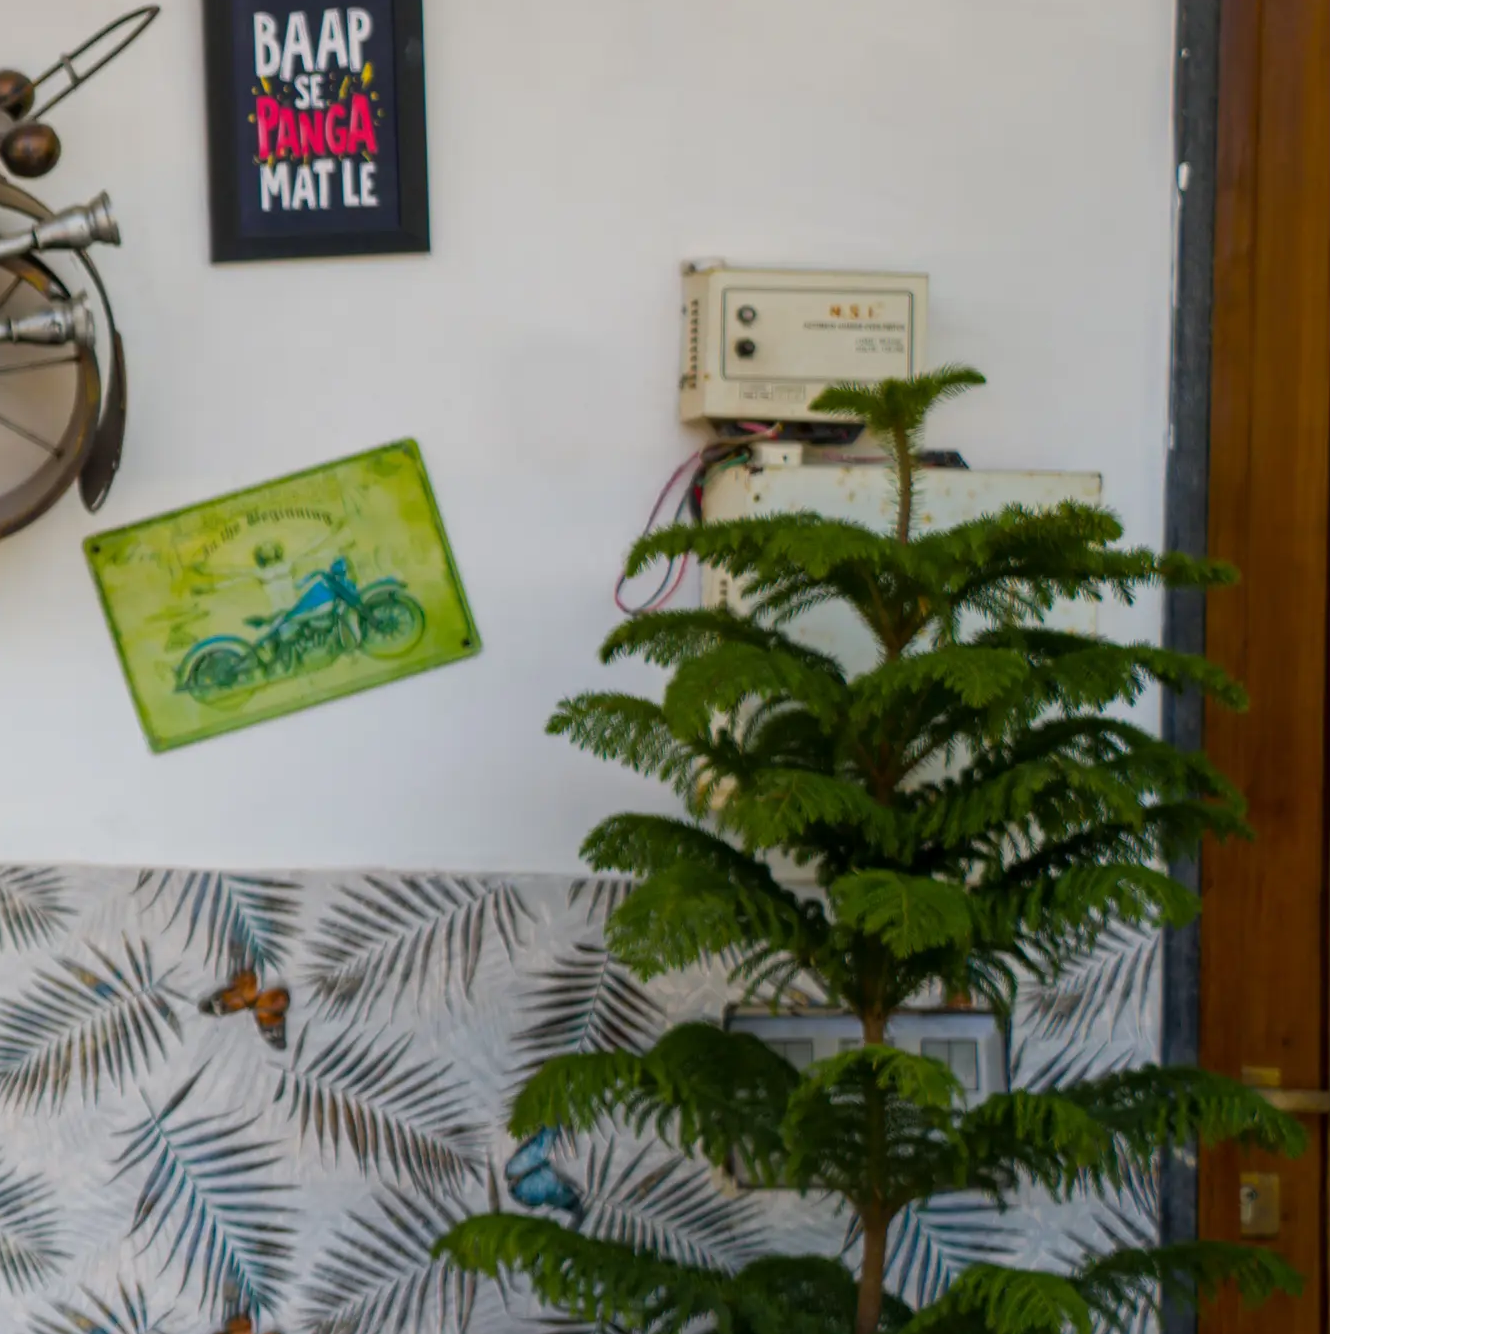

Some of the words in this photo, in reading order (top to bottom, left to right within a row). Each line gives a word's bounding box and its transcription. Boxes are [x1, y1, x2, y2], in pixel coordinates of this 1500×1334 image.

[254, 6, 373, 82] BAAP
[295, 74, 325, 110] SE
[256, 93, 378, 160] PANGA
[260, 158, 335, 212] MAT
[341, 157, 379, 207] LE
[221, 521, 241, 545] the
[245, 506, 336, 528] Beginning
